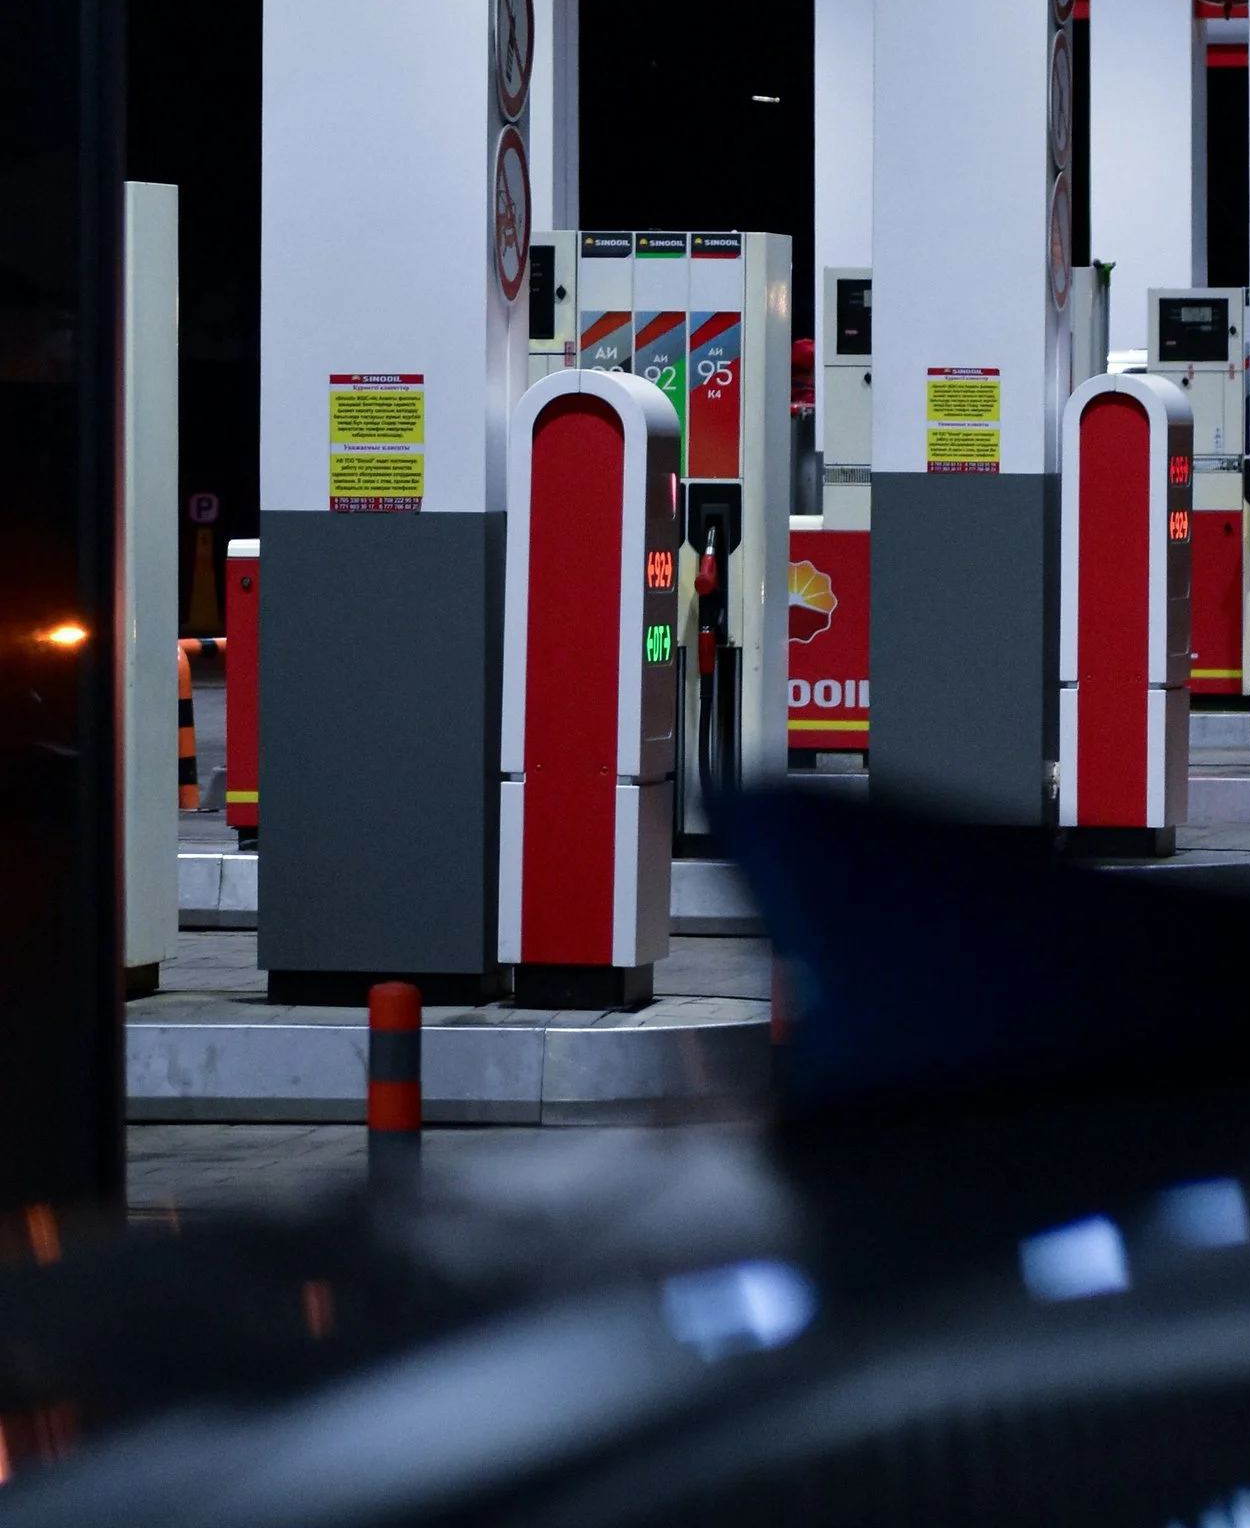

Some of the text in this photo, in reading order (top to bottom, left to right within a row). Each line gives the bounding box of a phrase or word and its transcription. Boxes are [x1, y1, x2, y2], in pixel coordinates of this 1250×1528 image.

[595, 239, 631, 247] SINOOIL
[649, 239, 685, 247] SINOOIL
[704, 239, 740, 247] SINOOIL
[708, 348, 723, 357] АИ
[697, 360, 733, 386] 95
[362, 375, 403, 383] SINOOIL
[644, 366, 678, 391] 92
[196, 496, 213, 519] P
